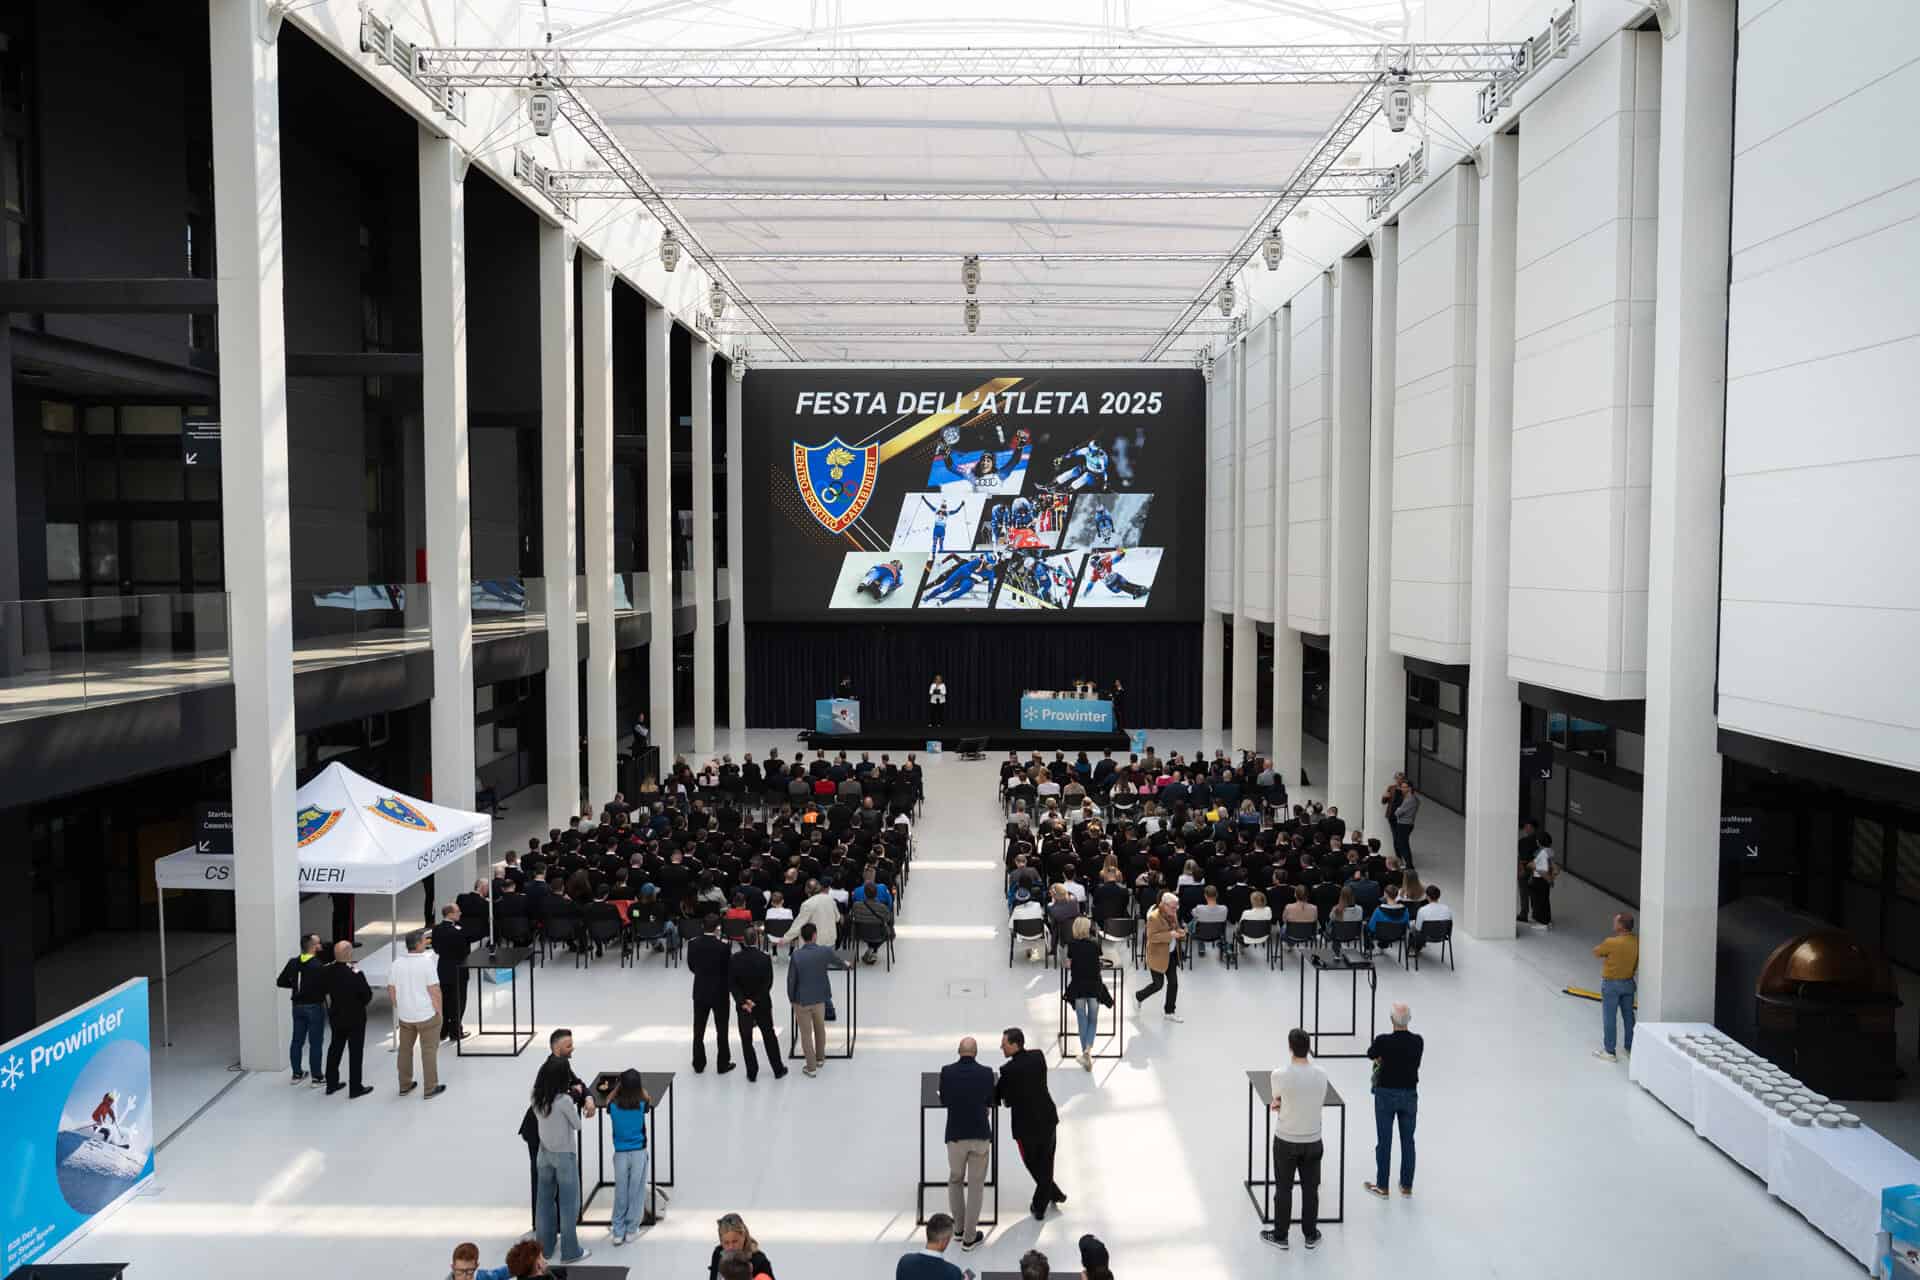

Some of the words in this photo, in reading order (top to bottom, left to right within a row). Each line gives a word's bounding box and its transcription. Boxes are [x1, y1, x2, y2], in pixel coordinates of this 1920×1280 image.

[795, 391, 888, 416] FESTA
[896, 391, 1089, 416] DELL'ATLETA
[1100, 391, 1163, 416] 2025
[804, 487, 839, 529] SPORTIVO
[842, 456, 878, 525] CARABINIERI
[1042, 708, 1108, 723] Prowinter
[416, 855, 429, 871] CS
[429, 831, 475, 864] CARABINIERI
[204, 865, 230, 880] CS
[298, 867, 346, 883] NIERI
[30, 1007, 125, 1075] Prowinter
